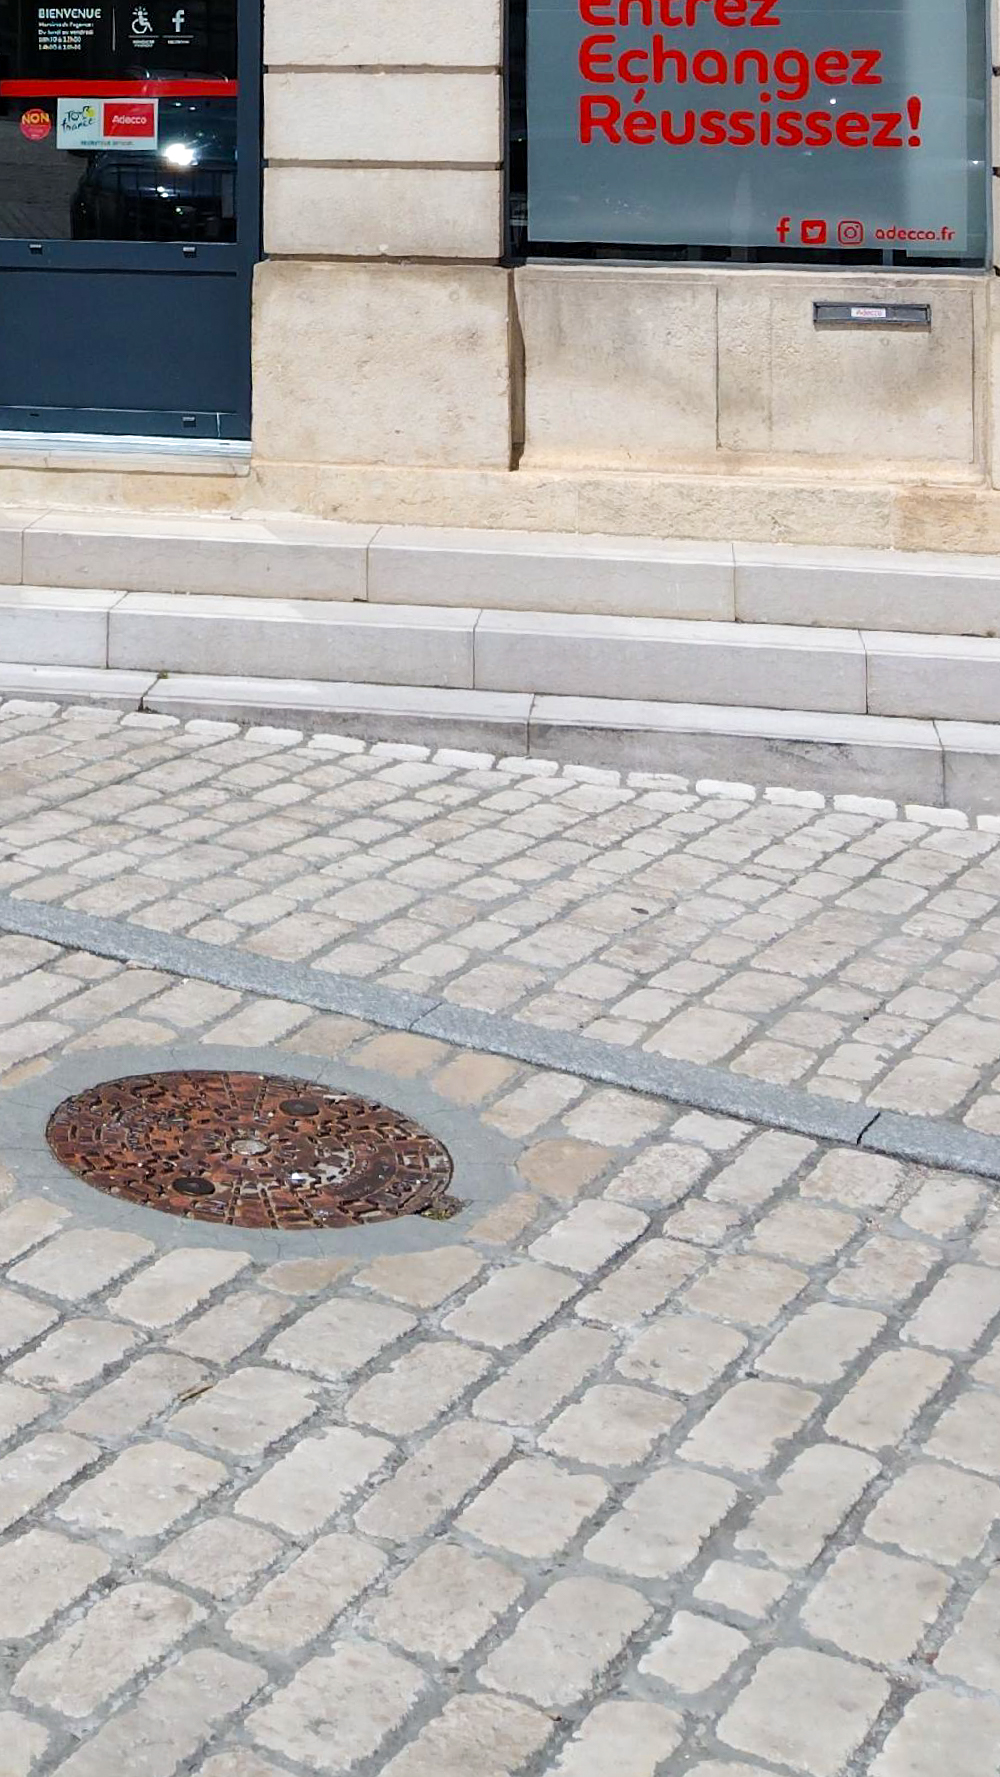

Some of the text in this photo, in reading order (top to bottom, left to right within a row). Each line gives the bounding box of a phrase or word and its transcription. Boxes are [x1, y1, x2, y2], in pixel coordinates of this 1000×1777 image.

[38, 8, 102, 19] BIENVENUE
[578, 32, 882, 103] Echangez
[21, 112, 50, 124] NON
[111, 114, 147, 125] Adecco
[579, 87, 923, 148] Réussissez!
[874, 225, 955, 242] adecco.fr
